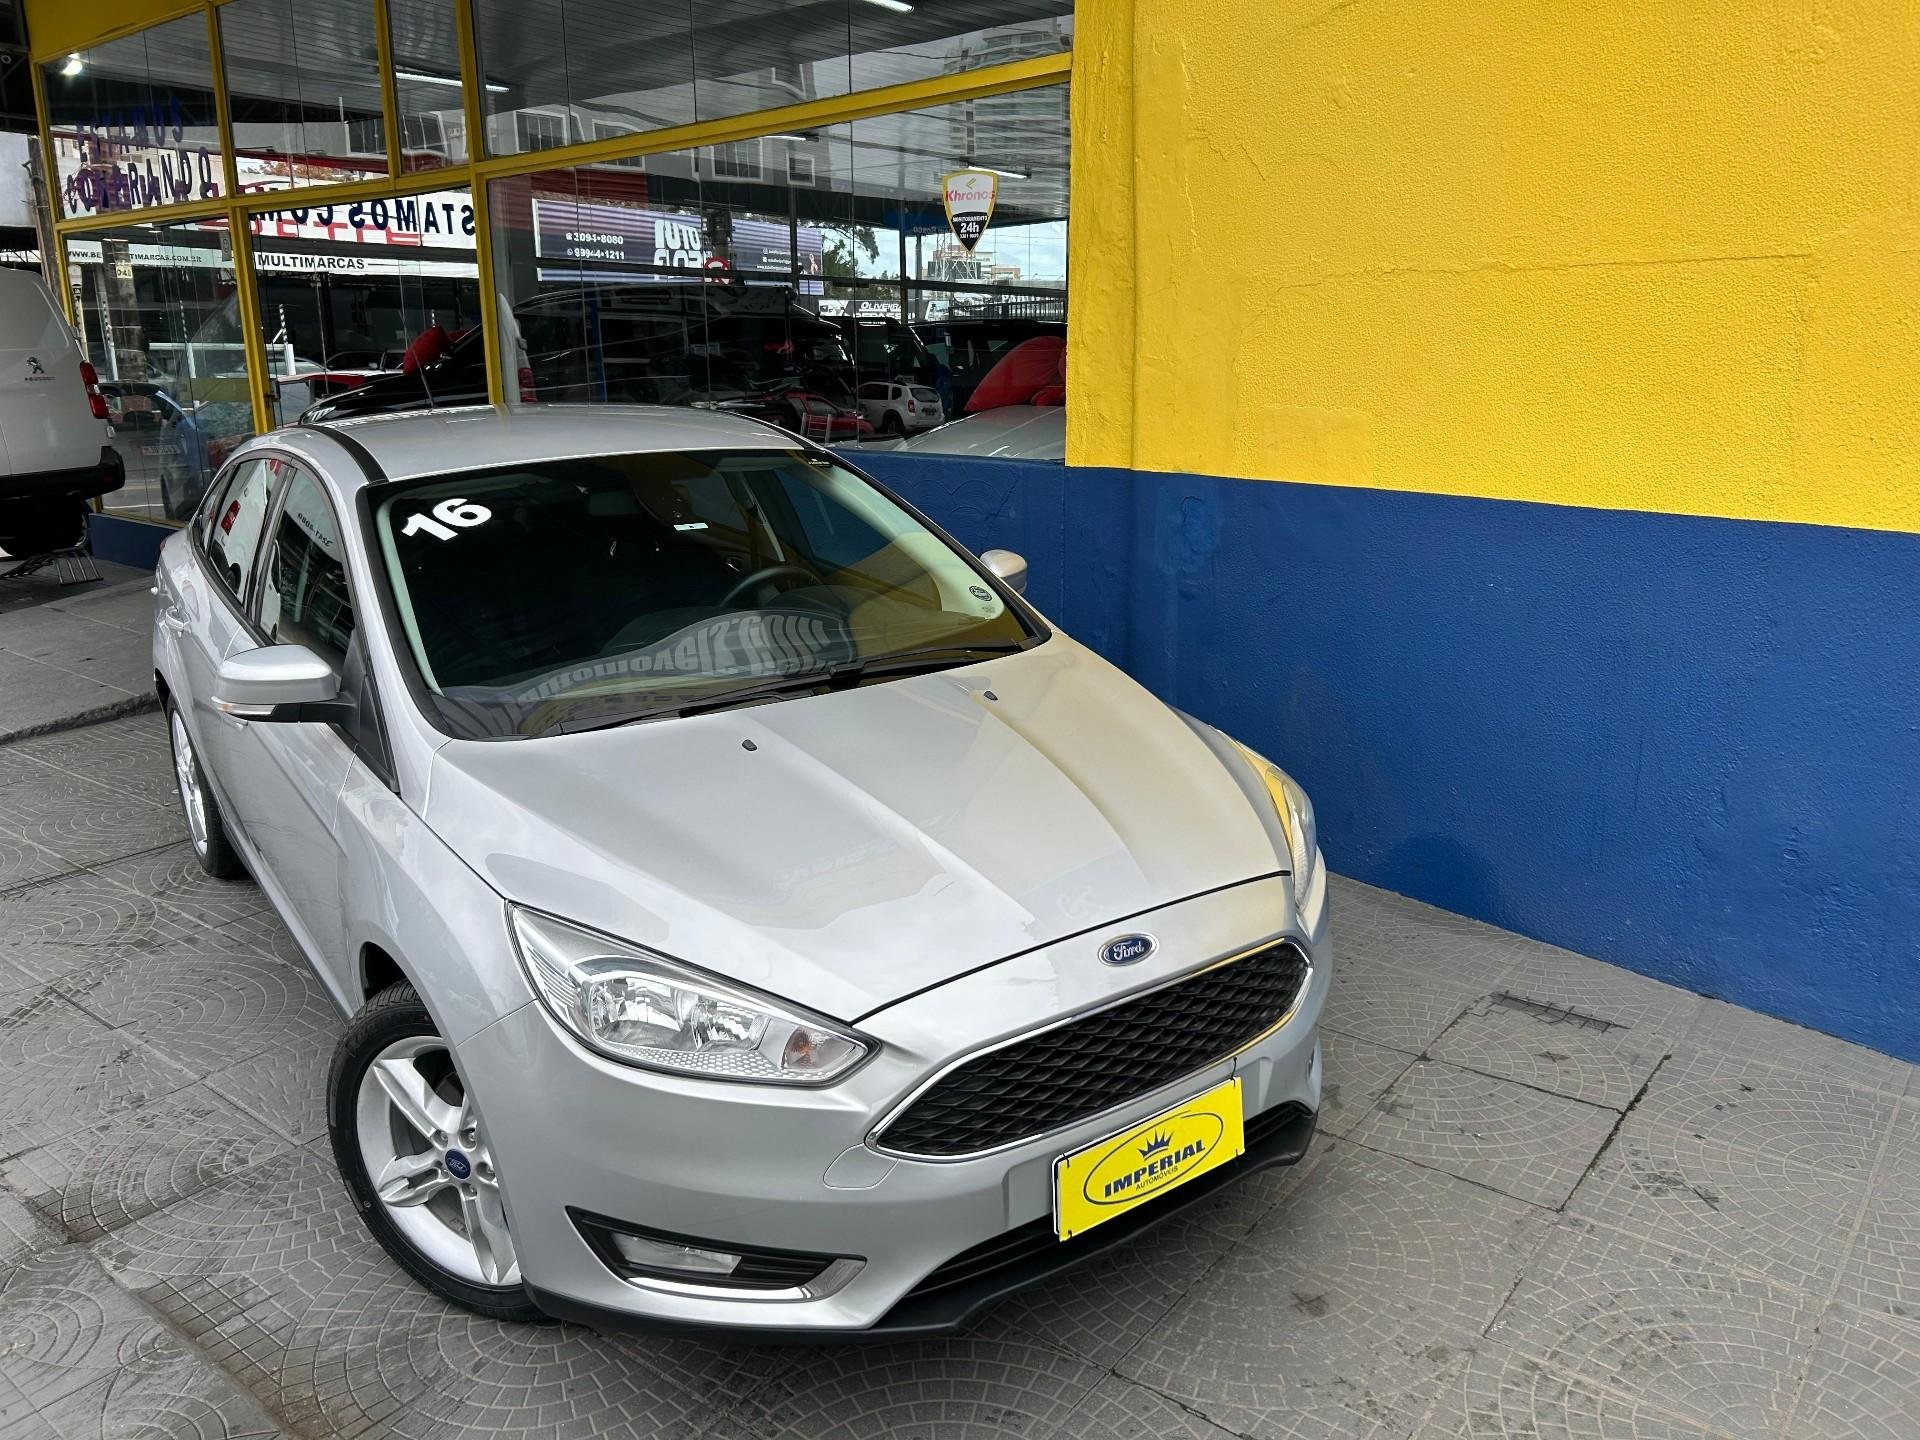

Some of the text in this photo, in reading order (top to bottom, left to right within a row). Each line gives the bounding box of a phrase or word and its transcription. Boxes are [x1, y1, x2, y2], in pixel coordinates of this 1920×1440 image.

[945, 190, 996, 202] Khronos
[960, 222, 980, 233] 24h
[257, 254, 365, 270] MULTIMARCAS
[401, 498, 492, 541] 16
[1112, 940, 1145, 961] Ford
[1104, 1139, 1206, 1198] IMPERIAL
